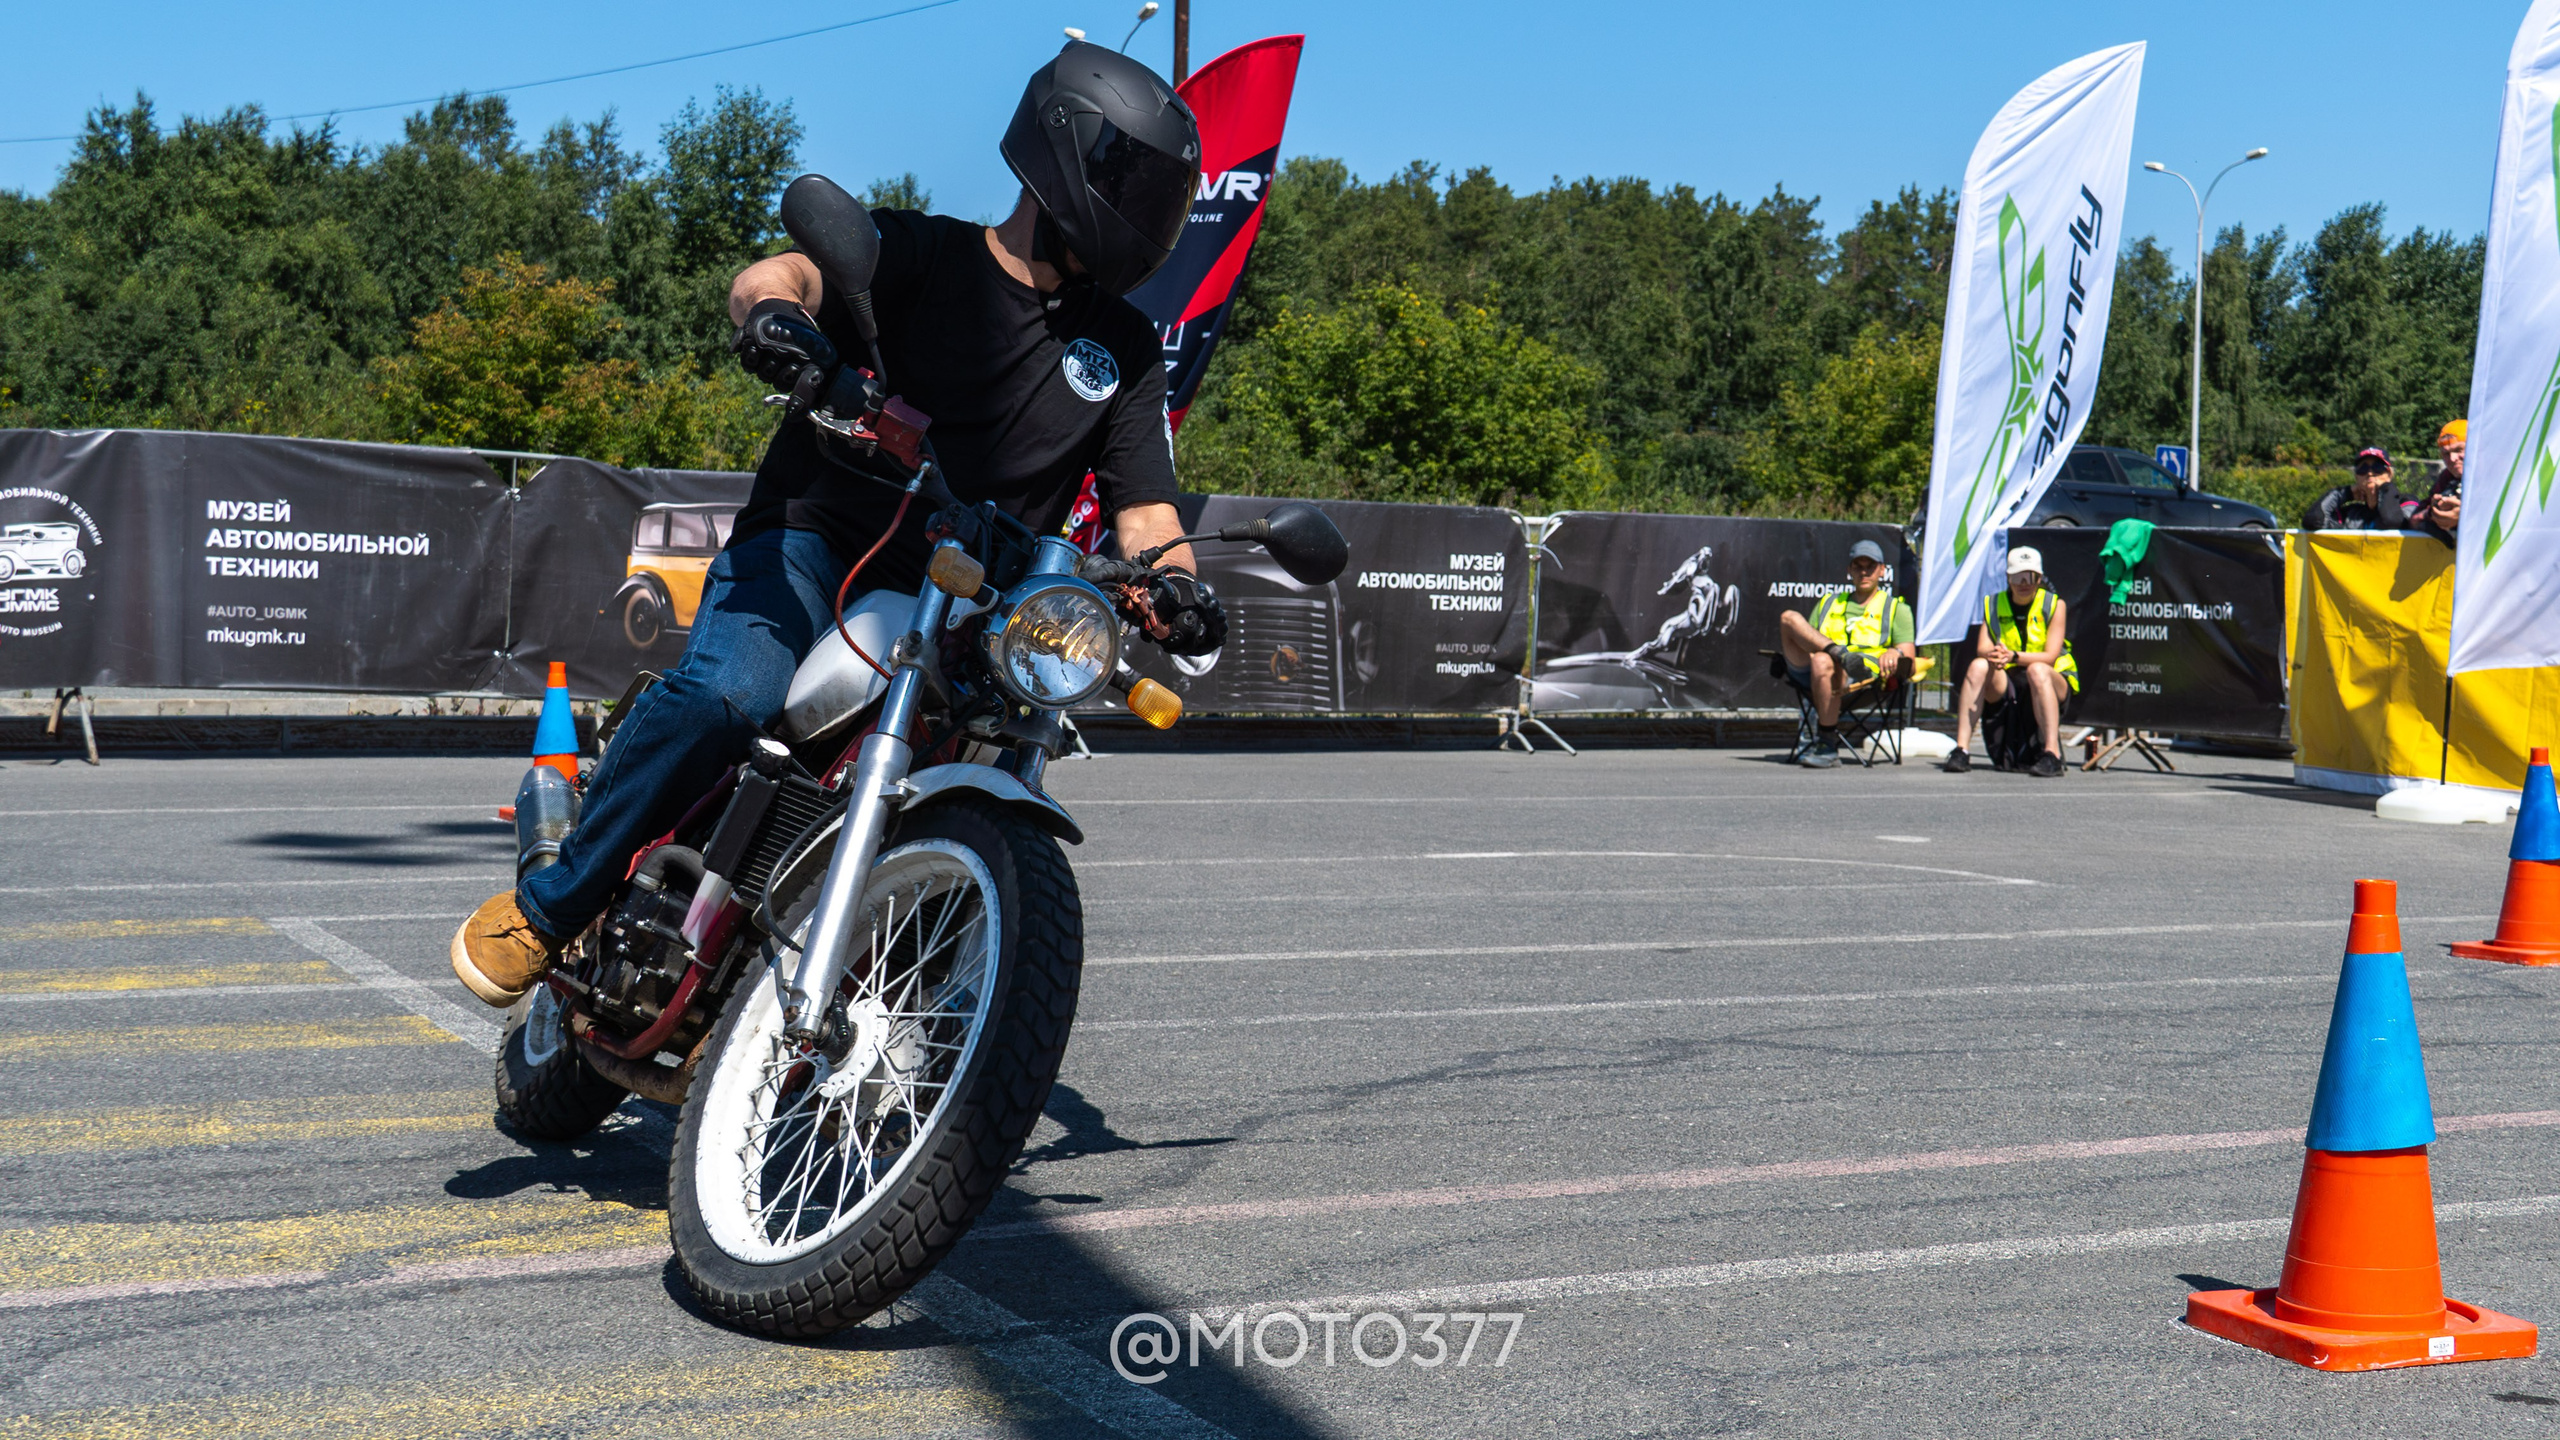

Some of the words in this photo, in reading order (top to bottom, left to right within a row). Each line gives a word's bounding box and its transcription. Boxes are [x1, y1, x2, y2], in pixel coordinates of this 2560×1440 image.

[1195, 170, 1262, 201] VR
[207, 498, 291, 523] МУЗЕЙ
[69, 501, 103, 546] ТЕХНИКИ
[205, 527, 430, 556] АВТОМОБИЛЬНОЙ
[205, 556, 319, 580] ТЕХНИКИ
[1450, 552, 1505, 571] МУЗЕЙ
[1357, 572, 1504, 592] АВТОМОБИЛЬНОЙ
[207, 605, 308, 621] #AUTO_UGMK
[1429, 594, 1503, 612] ТЕХНИКИ
[2108, 602, 2233, 620] АВТОМОБИЛЬНОЙ
[22, 621, 63, 637] MUSEUM
[206, 626, 306, 647] mkugmk.ru
[2108, 624, 2168, 640] ТЕХНИКИ
